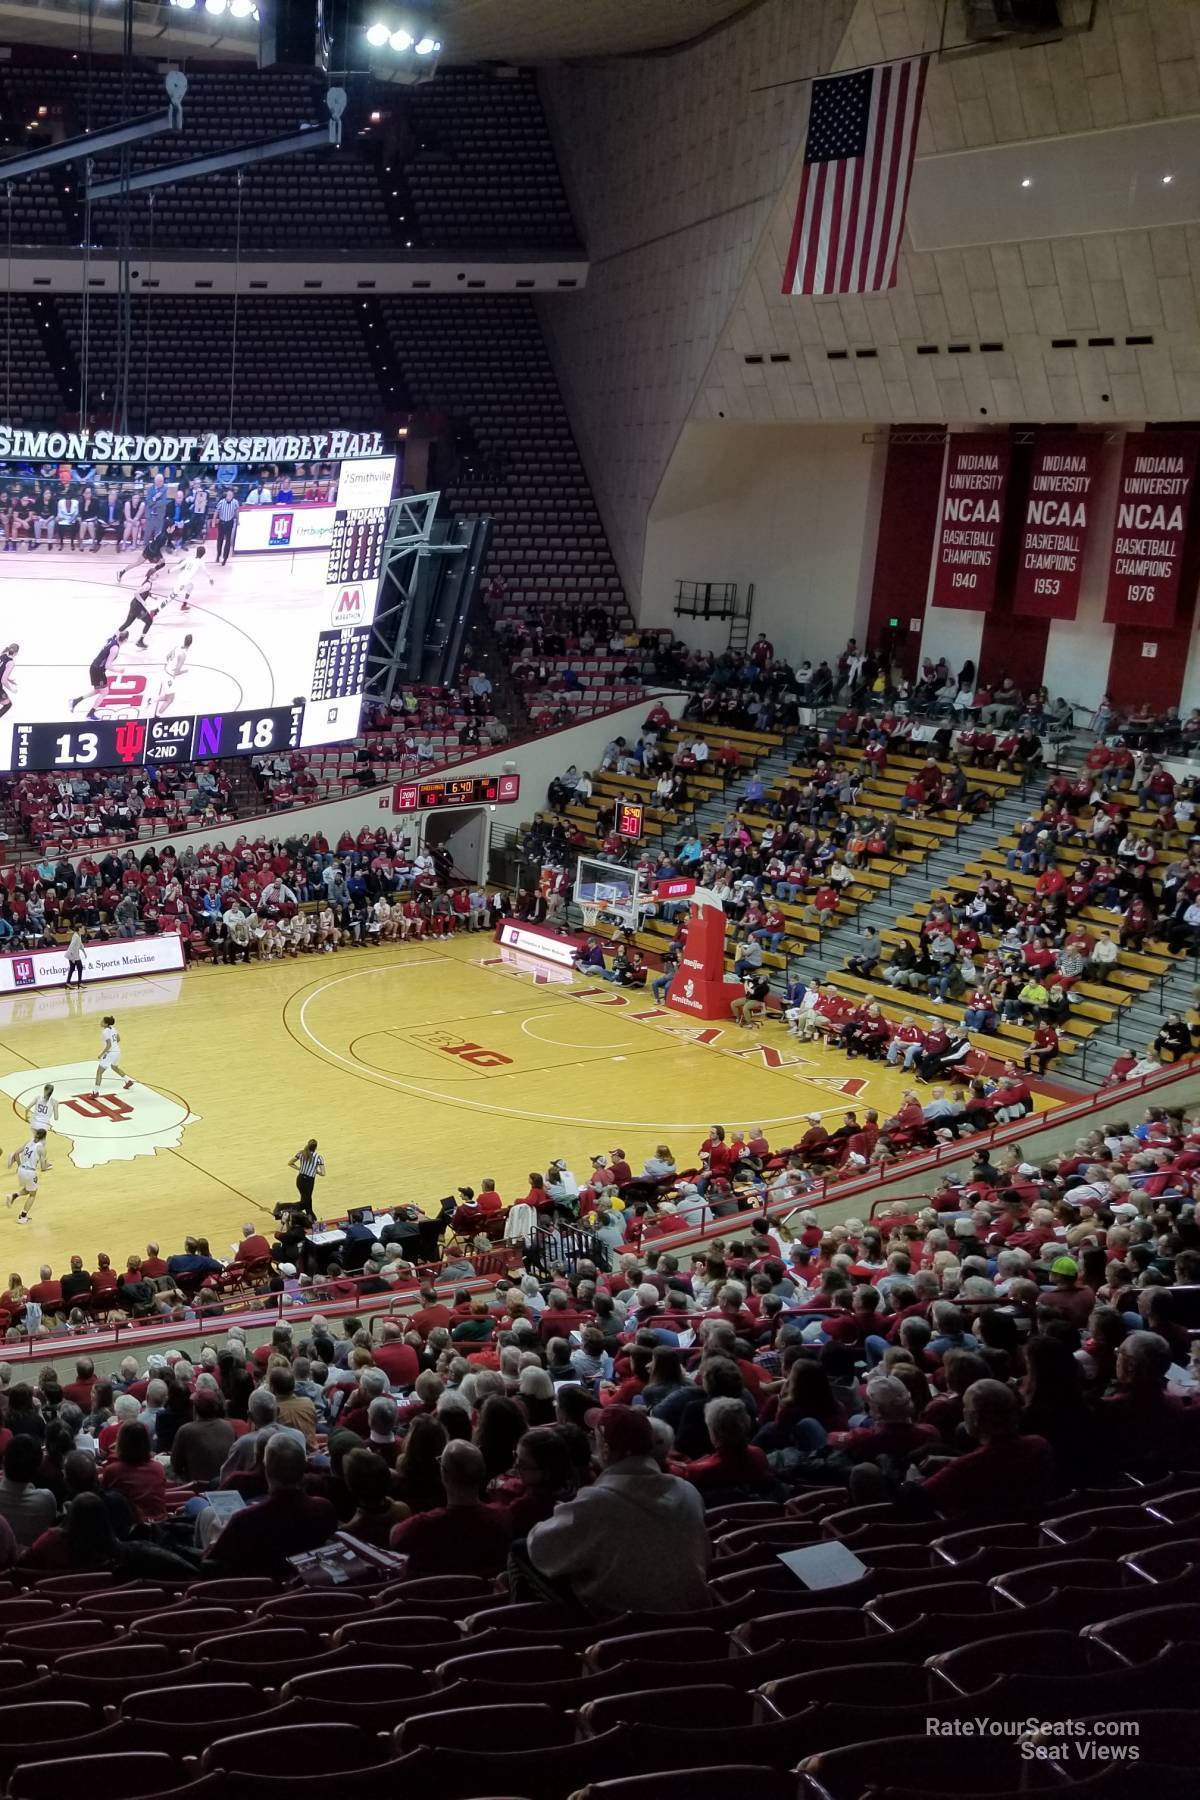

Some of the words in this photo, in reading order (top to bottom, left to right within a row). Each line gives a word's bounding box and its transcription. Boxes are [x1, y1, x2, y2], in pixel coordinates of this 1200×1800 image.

[92, 430, 198, 462] SKJODT
[200, 432, 328, 462] ASSEMBLY
[328, 431, 383, 458] HALL
[957, 455, 998, 470] INDIANA
[1042, 455, 1086, 472] INDIANA
[1134, 457, 1183, 473] INDIANA
[350, 472, 391, 483] Smithville
[950, 474, 1003, 490] UNIVERSITY
[1033, 476, 1090, 492] UNIVERSITY
[1124, 478, 1189, 494] UNIVERSITY
[347, 508, 385, 520] INDIANA
[944, 498, 1000, 523] NCAA
[1026, 500, 1086, 527] NCAA
[1117, 504, 1183, 531] NCAA
[334, 527, 344, 537] 10
[348, 527, 353, 536] 0
[359, 526, 364, 535] 0
[369, 525, 374, 534] 3
[379, 524, 384, 533] 0
[943, 529, 995, 547] BASKETBALL
[332, 539, 341, 548] 11
[346, 538, 351, 547] 0
[357, 537, 362, 546] 1
[367, 536, 373, 545] 0
[377, 535, 382, 544] 0
[1025, 534, 1080, 552] BASKETBALL
[1115, 538, 1176, 557] BASKETBALL
[331, 550, 340, 559] 13
[345, 549, 350, 558] 0
[356, 549, 360, 558] 1
[366, 548, 371, 557] 1
[376, 546, 380, 556] 1
[943, 549, 991, 565] CHAMPIONS
[329, 561, 339, 570] 34
[343, 560, 349, 569] 4
[354, 559, 359, 568] 0
[364, 559, 369, 568] 2
[374, 558, 380, 566] 0
[1025, 554, 1076, 572] CHAMPIONS
[1115, 558, 1171, 577] CHAMPIONS
[952, 573, 977, 588] 1940
[1034, 579, 1060, 595] 1953
[338, 590, 360, 612] M
[1127, 585, 1155, 602] 1976
[341, 628, 354, 639] NU
[319, 648, 325, 657] 3
[331, 646, 337, 656] 2
[341, 645, 347, 654] 0
[352, 643, 357, 653] 0
[362, 642, 367, 651] 0
[330, 657, 335, 666] 5
[340, 656, 346, 665] 3
[350, 655, 356, 664] 2
[360, 653, 365, 662] 0
[328, 668, 334, 677] 0
[338, 667, 344, 676] 1
[349, 665, 354, 674] 3
[359, 664, 364, 673] 1
[327, 678, 332, 687] 3
[337, 677, 343, 686] 0
[347, 676, 352, 685] 5
[357, 674, 363, 683] 0
[152, 720, 190, 738] 6:40
[198, 717, 223, 755] N
[236, 719, 273, 750] 18
[20, 734, 29, 745] 1
[55, 733, 98, 764] 13
[18, 755, 27, 766] 3
[624, 807, 640, 818] 6:40
[622, 816, 637, 833] 30
[16, 963, 30, 979] IU
[96, 959, 120, 972] Sports
[122, 954, 155, 965] Medicine
[683, 959, 704, 970] meijer
[672, 995, 703, 1010] Smithville
[469, 956, 871, 1100] INDIANA
[37, 1104, 48, 1114] 50
[58, 1092, 134, 1122] IU
[24, 1147, 33, 1159] 34
